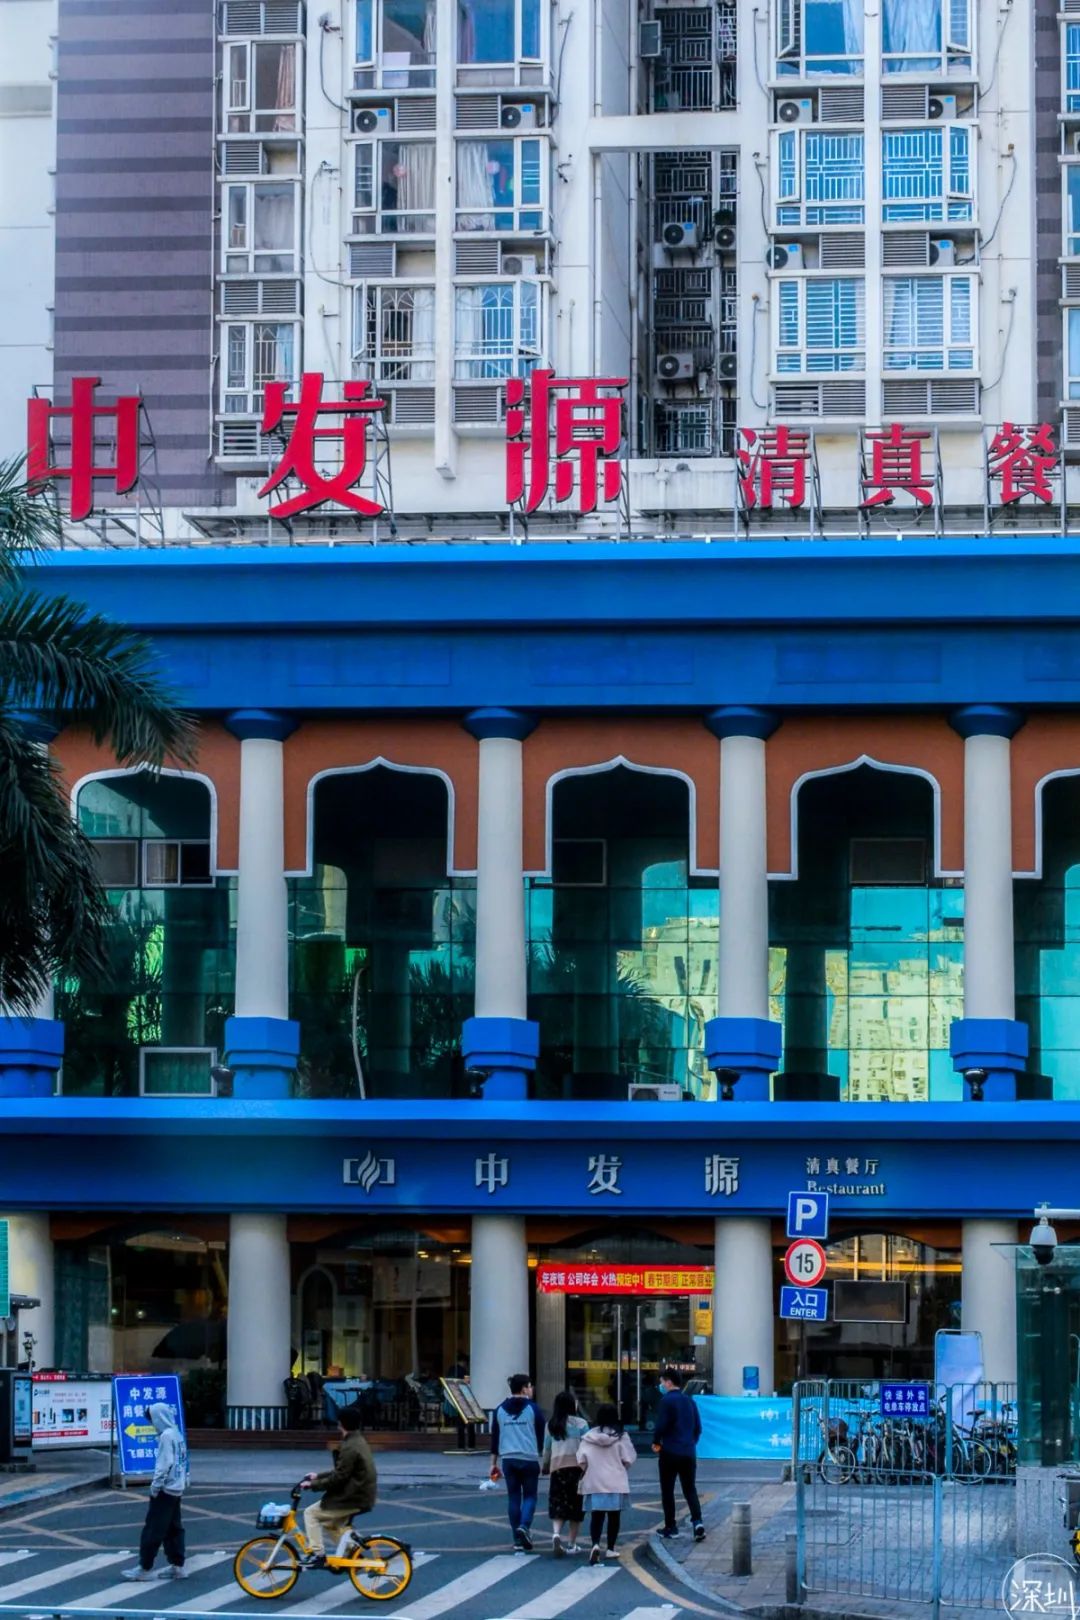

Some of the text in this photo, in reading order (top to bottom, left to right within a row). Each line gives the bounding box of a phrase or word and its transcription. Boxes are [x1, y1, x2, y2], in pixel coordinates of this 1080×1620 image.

[27, 368, 1060, 523] 中发源 清真餐
[475, 1152, 740, 1196] 中发源
[806, 1157, 880, 1176] 清真餐厅
[795, 1198, 818, 1231] P
[796, 1252, 814, 1274] 15
[567, 1271, 599, 1287] 公司年会
[791, 1291, 818, 1307] 入口
[790, 1307, 817, 1318] ENTER
[129, 1387, 167, 1401] 中发源
